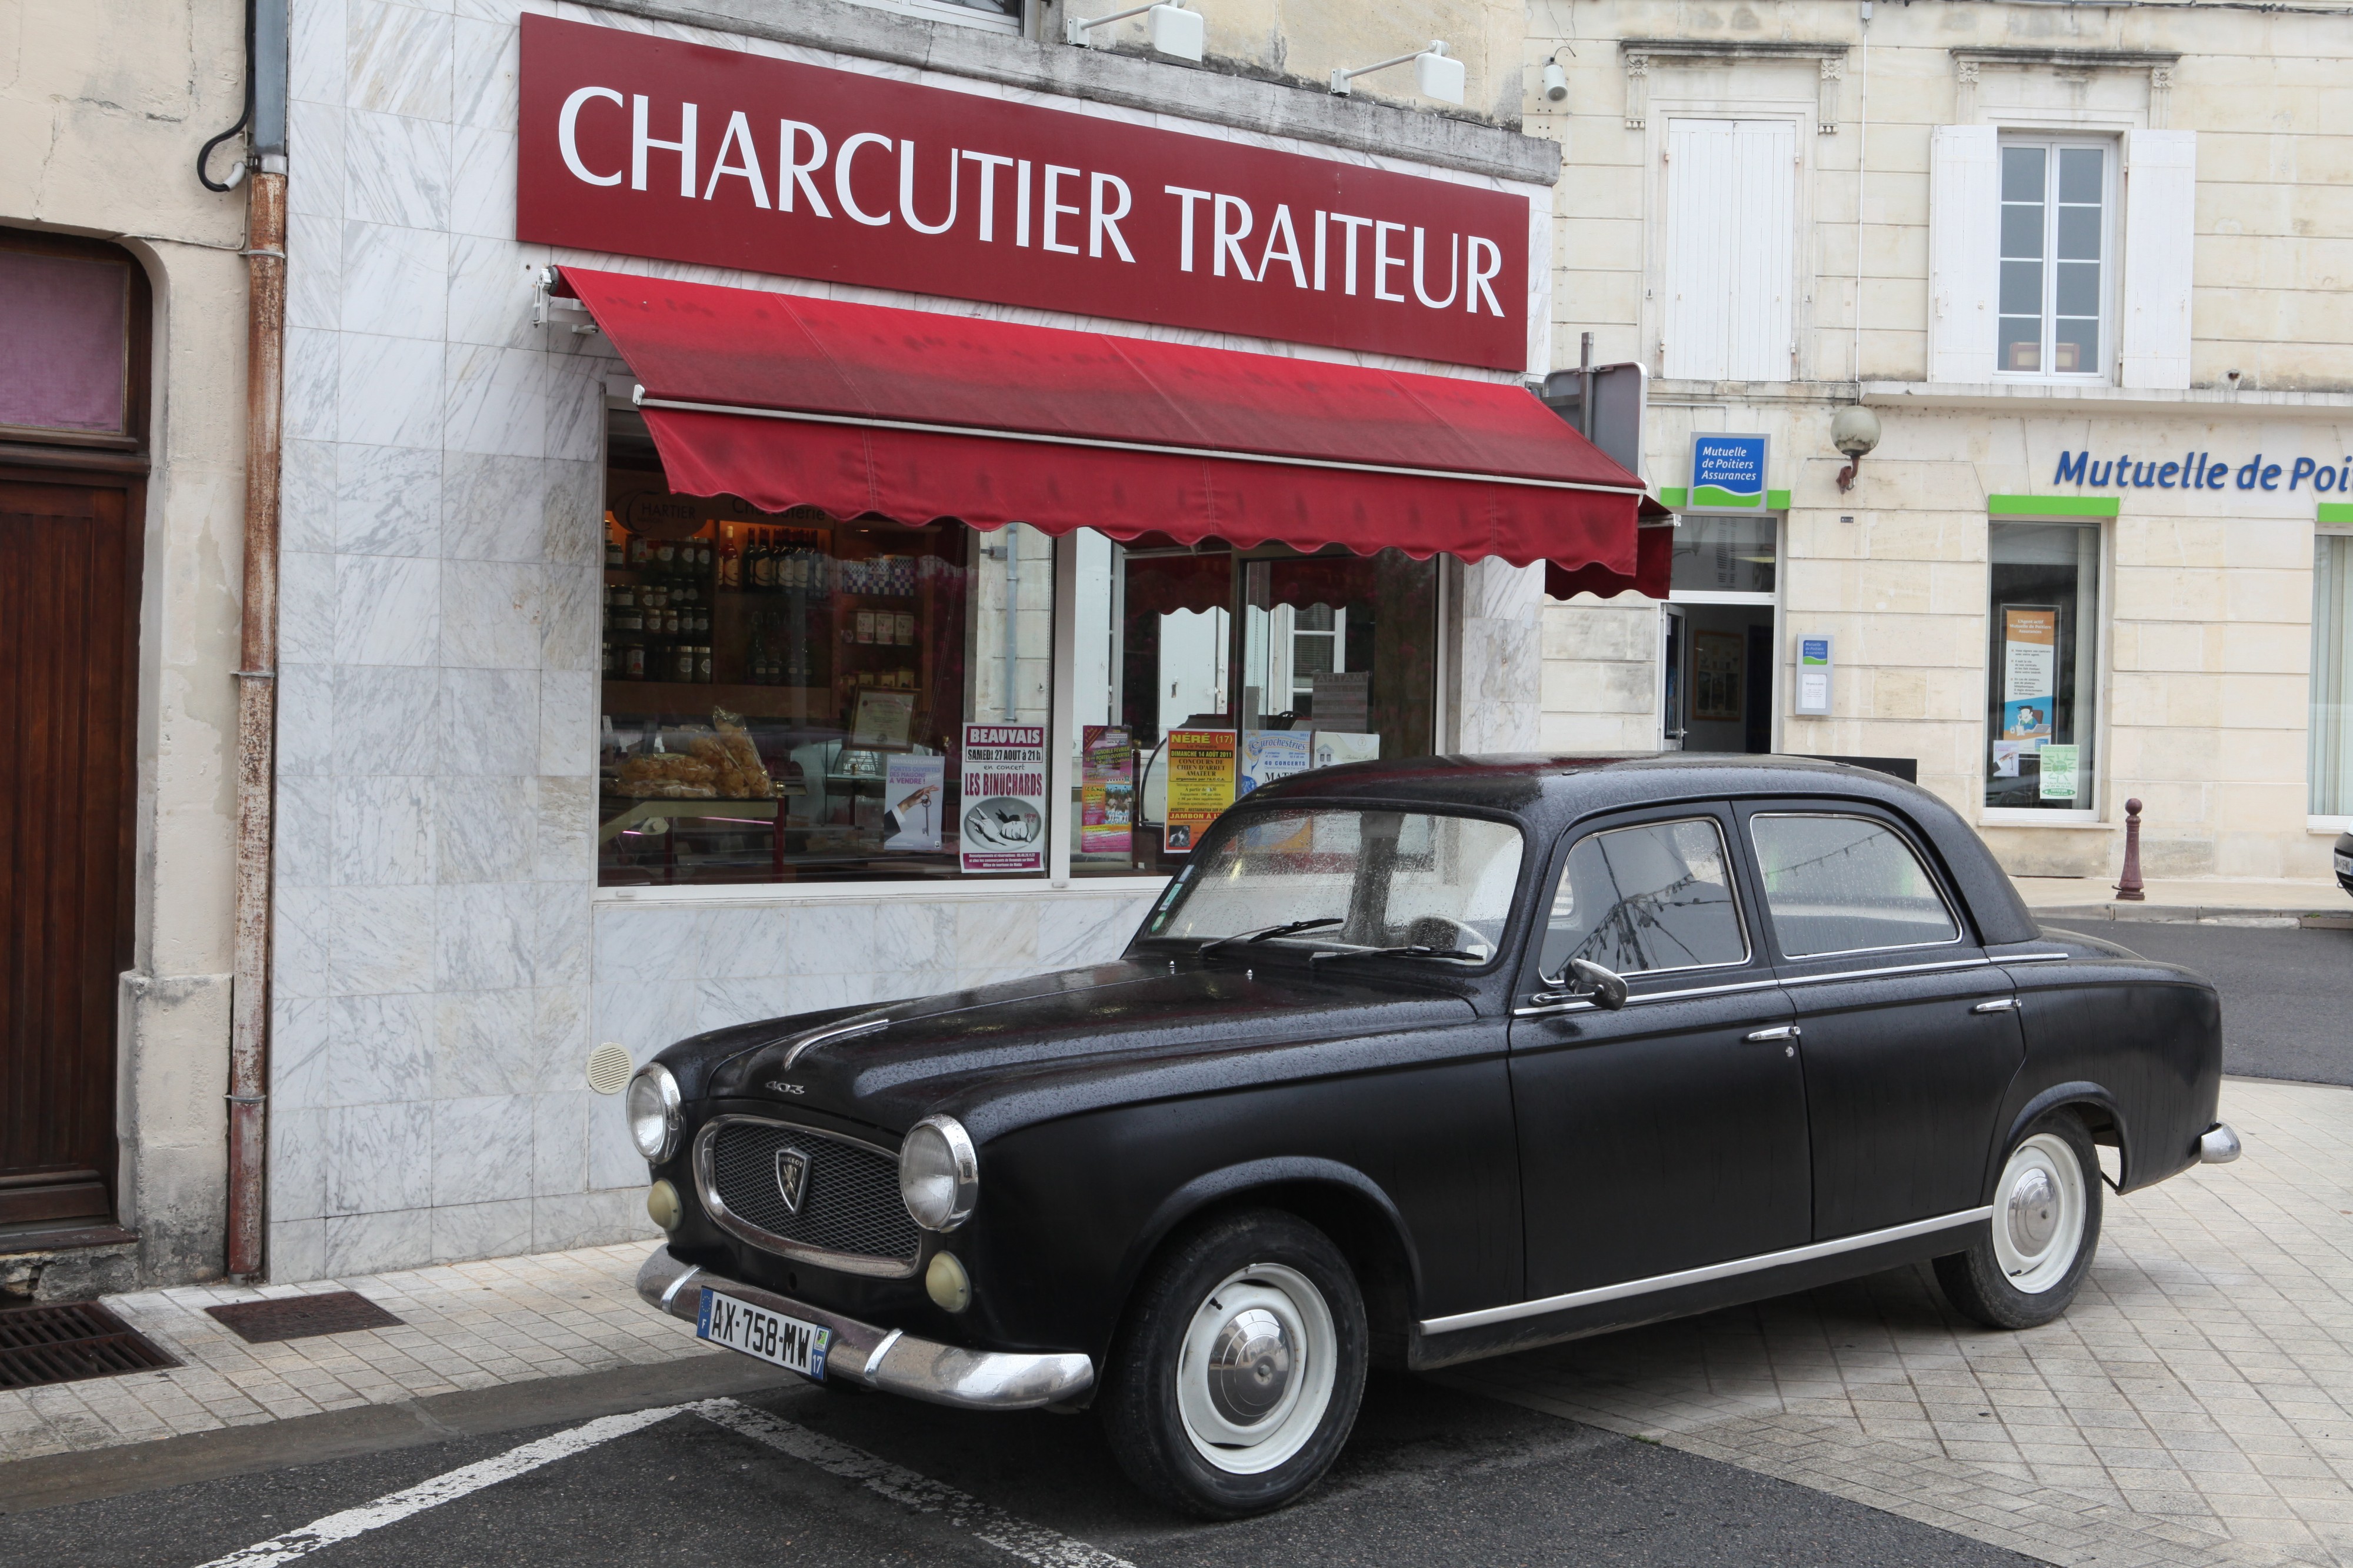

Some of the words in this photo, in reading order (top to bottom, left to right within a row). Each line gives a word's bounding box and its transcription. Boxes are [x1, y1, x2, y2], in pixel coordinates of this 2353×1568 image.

[559, 86, 1136, 262] CHARCUTIER
[1165, 185, 1505, 317] TRAITEUR
[1703, 446, 1747, 456] Mutuelle
[1702, 458, 1714, 468] de
[1716, 459, 1754, 469] Poitiers
[1701, 470, 1757, 481] Assurances
[2054, 451, 2229, 489] Mutuelle
[2237, 454, 2282, 490] de
[2289, 457, 2353, 492] Poi
[970, 728, 1040, 744] BEAUVAIS
[1171, 732, 1211, 744] NÉRÉ
[1215, 735, 1233, 744] (17)
[968, 749, 993, 760] SAMEDI
[995, 750, 1002, 760] 27
[1004, 750, 1021, 760] AOUT
[1022, 750, 1026, 760] à
[1028, 750, 1035, 760] 21
[1037, 750, 1041, 760] h
[965, 773, 980, 796] LES
[983, 773, 1042, 796] BINUCHARDS
[765, 1081, 805, 1095] 403
[779, 1156, 804, 1167] PEUGEOT
[702, 1319, 707, 1330] F
[712, 1299, 810, 1368] AX-758-MW
[813, 1355, 823, 1374] 17
